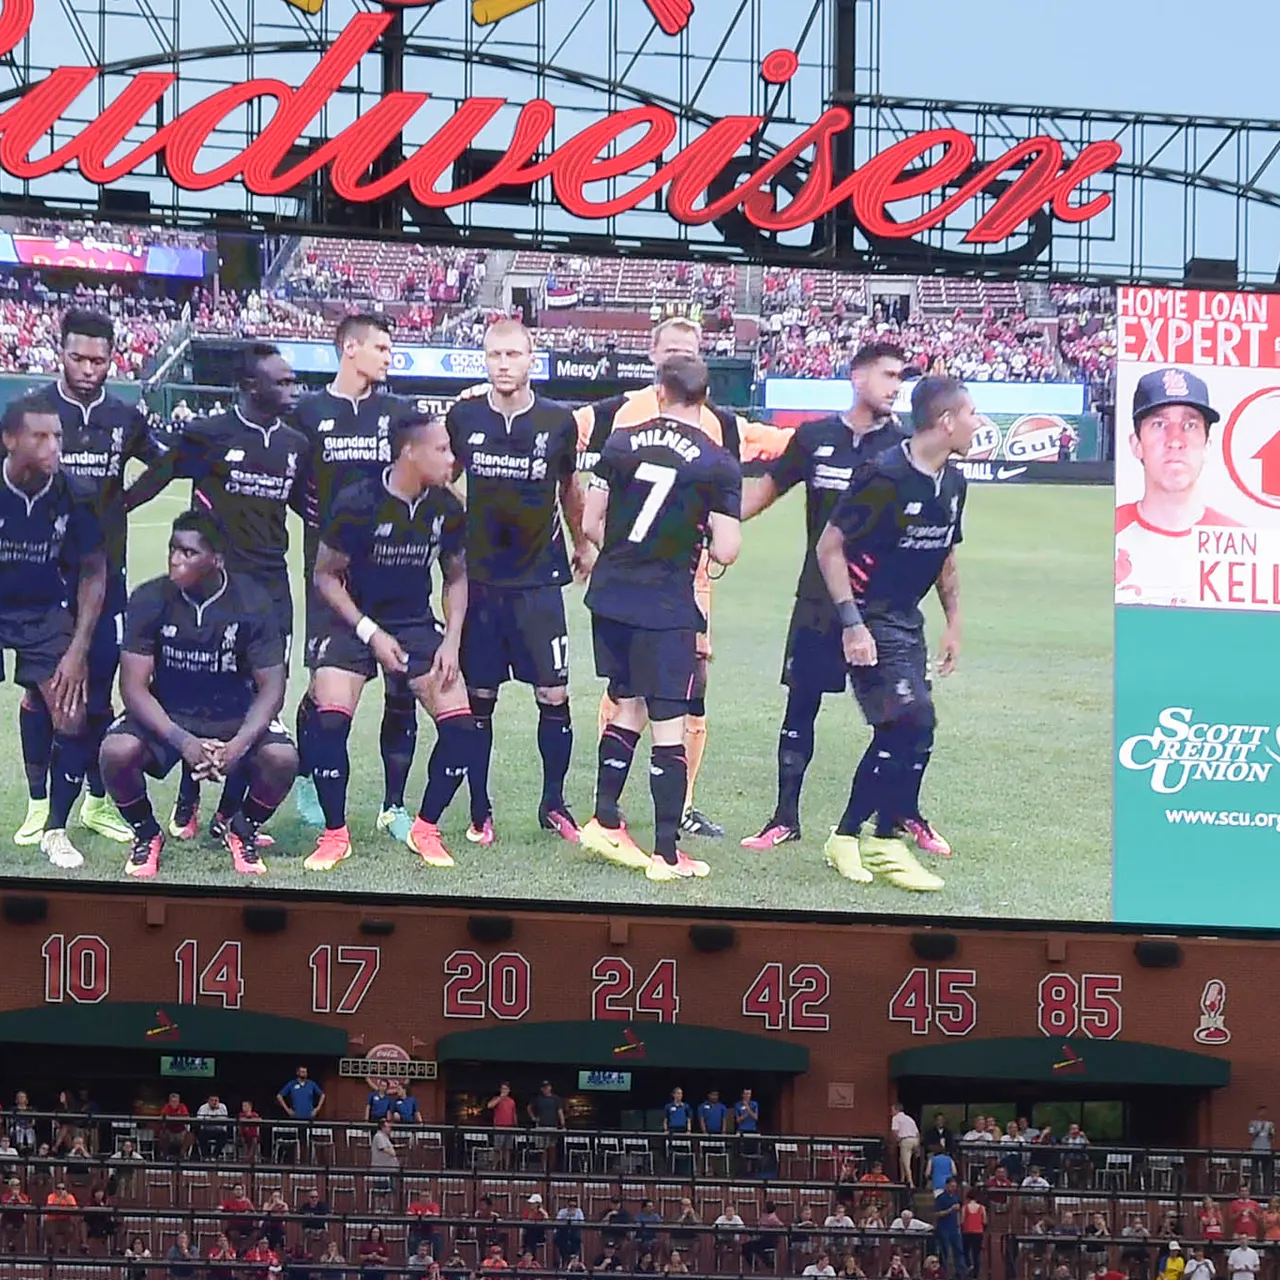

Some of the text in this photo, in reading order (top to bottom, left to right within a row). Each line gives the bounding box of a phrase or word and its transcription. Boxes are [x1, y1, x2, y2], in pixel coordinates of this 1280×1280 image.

[1117, 288, 1268, 323] HOME LOAN
[1118, 316, 1269, 368] EXPERT
[557, 360, 599, 380] Mercy
[59, 452, 110, 466] tandard
[324, 435, 377, 450] Standard
[472, 452, 530, 469] Standard
[630, 431, 701, 464] MILNER
[1007, 436, 1062, 458] Gul
[627, 461, 678, 544] 7
[1198, 530, 1258, 556] RYAN
[1158, 707, 1270, 745] SCOTT
[1118, 727, 1257, 771] CREDIT
[1150, 758, 1272, 793] UNION
[40, 933, 111, 1004] 10
[174, 938, 245, 1010] 14
[308, 944, 381, 1014] 17
[443, 949, 532, 1020] 20
[591, 956, 680, 1025] 24
[741, 961, 831, 1032] 42
[888, 967, 978, 1037] 45
[1037, 972, 1123, 1040] 85
[340, 1061, 436, 1077] SCOREBOARD
